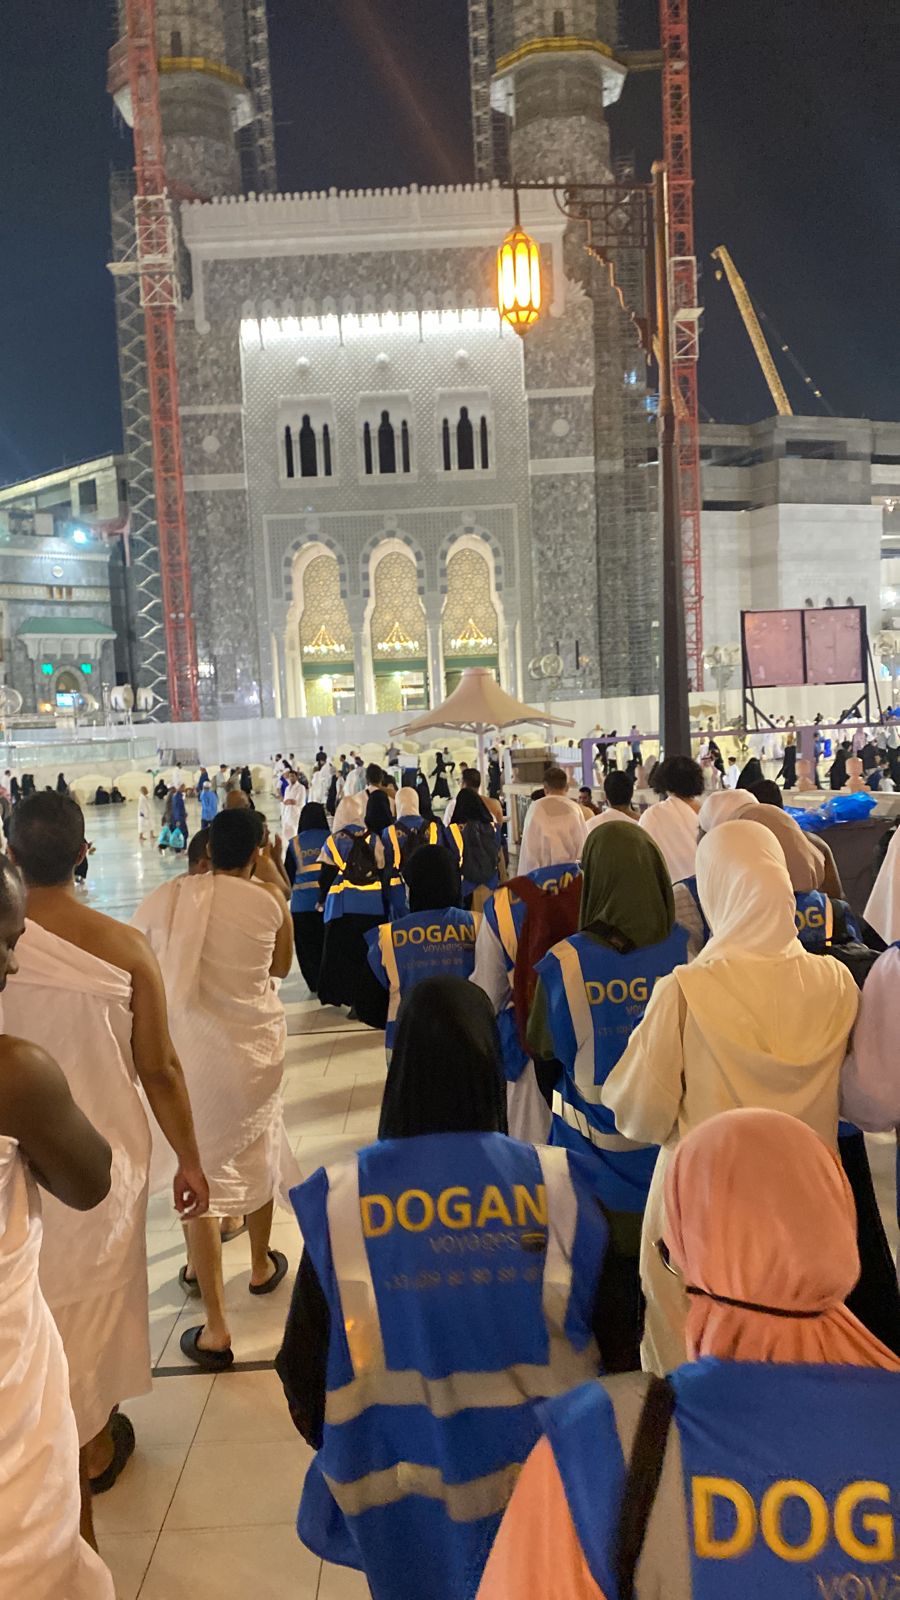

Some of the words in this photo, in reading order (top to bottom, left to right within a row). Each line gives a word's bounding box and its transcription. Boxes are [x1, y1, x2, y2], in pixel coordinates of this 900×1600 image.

[393, 924, 475, 947] DOGAN
[585, 976, 664, 1005] DOG
[360, 1184, 548, 1238] DOGAN
[691, 1475, 895, 1564] DOG
